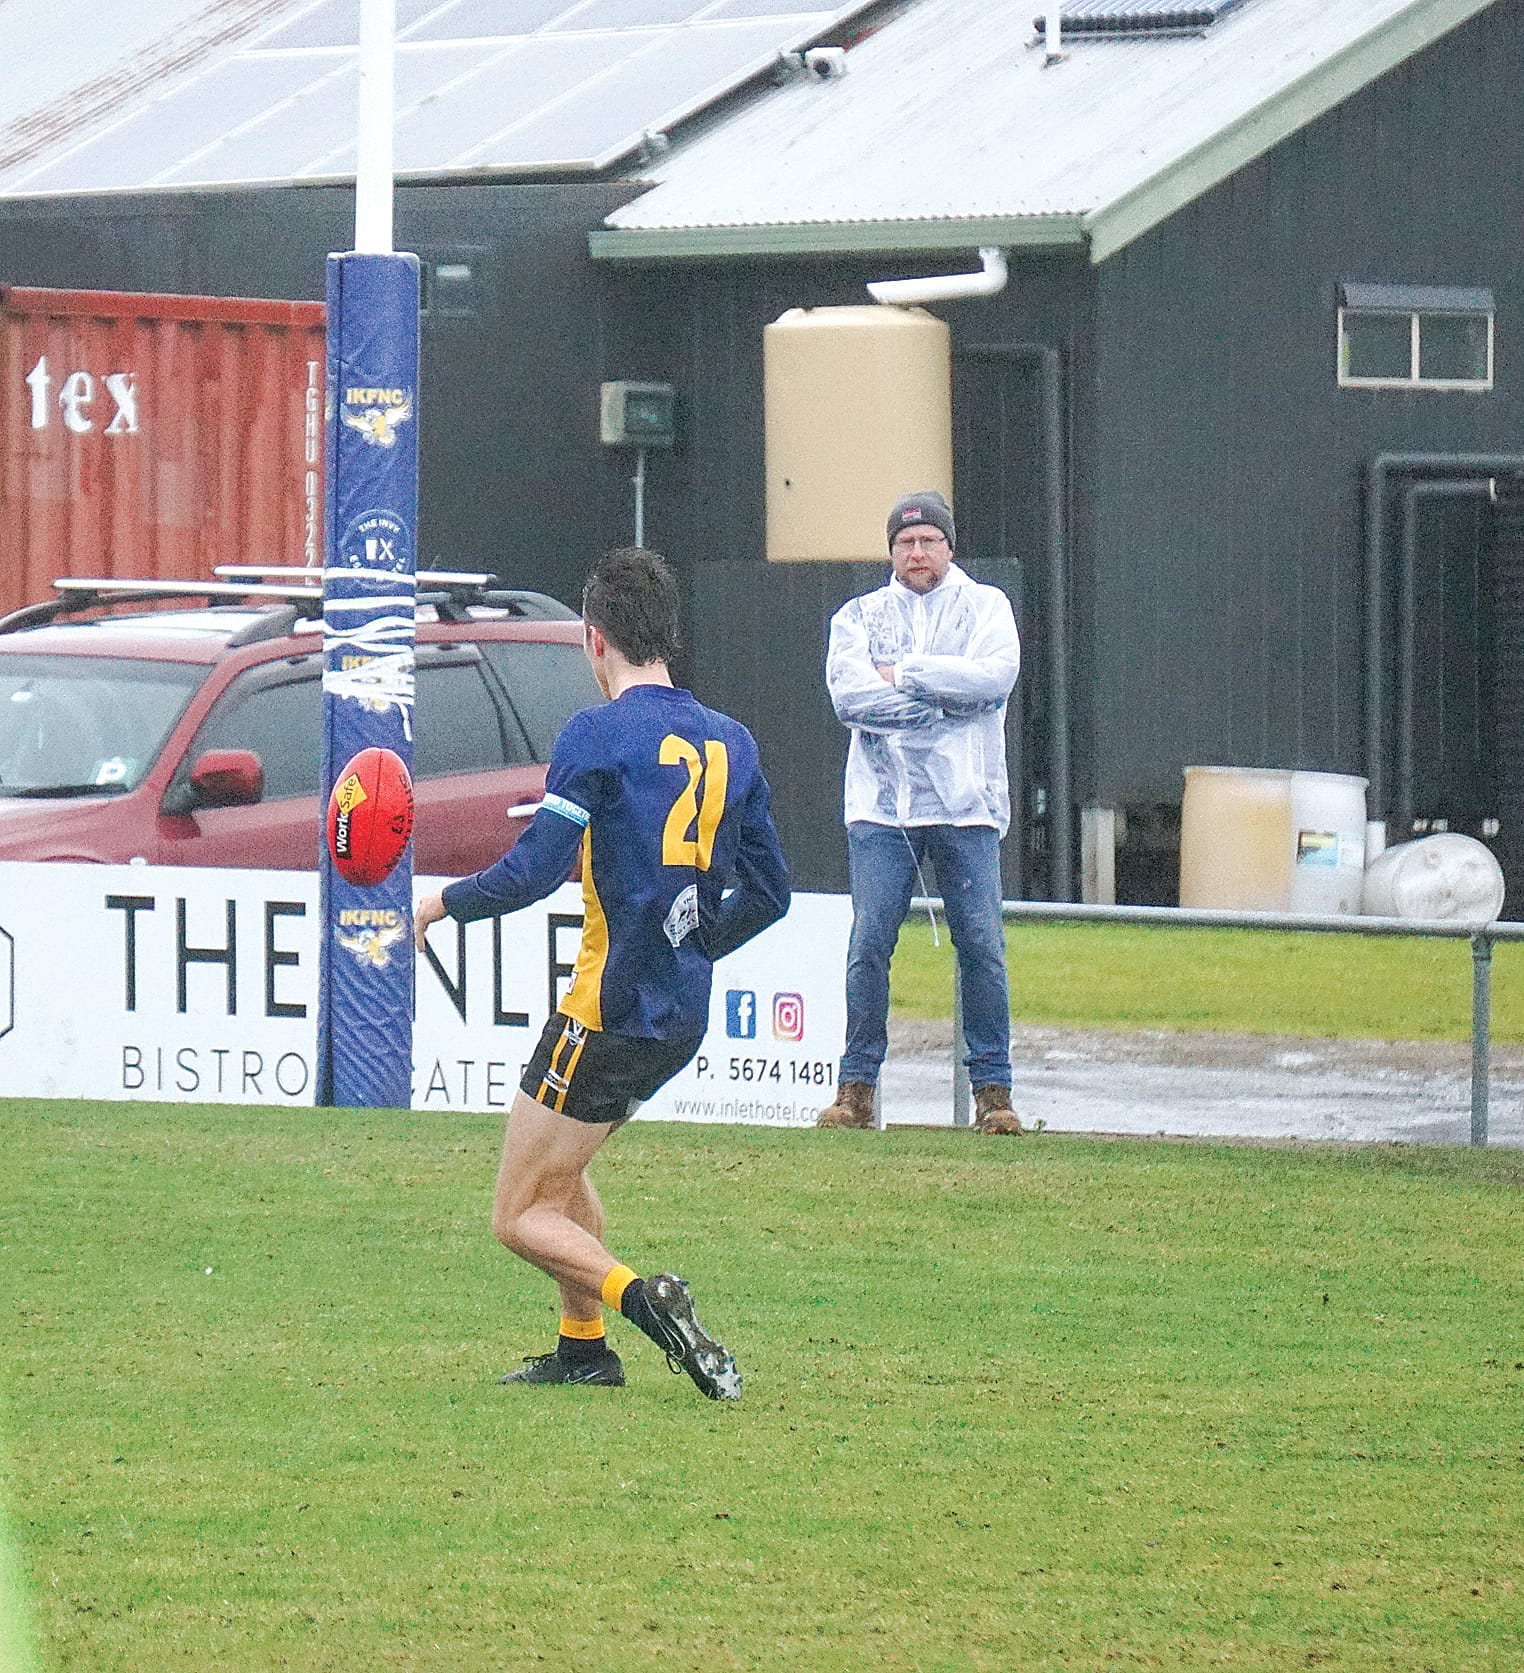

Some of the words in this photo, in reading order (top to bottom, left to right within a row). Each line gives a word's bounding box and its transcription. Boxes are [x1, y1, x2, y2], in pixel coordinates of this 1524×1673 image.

[25, 355, 140, 434] tex
[346, 388, 404, 405] IKFNC
[659, 733, 728, 872] 21
[340, 909, 398, 926] IKFNC
[105, 895, 307, 1018] THE
[413, 913, 587, 1028] NLE
[122, 1046, 309, 1096] BISTRO
[729, 1058, 782, 1084] 5674
[789, 1061, 833, 1086] 1481
[673, 1097, 822, 1122] www.inlethotel.co
